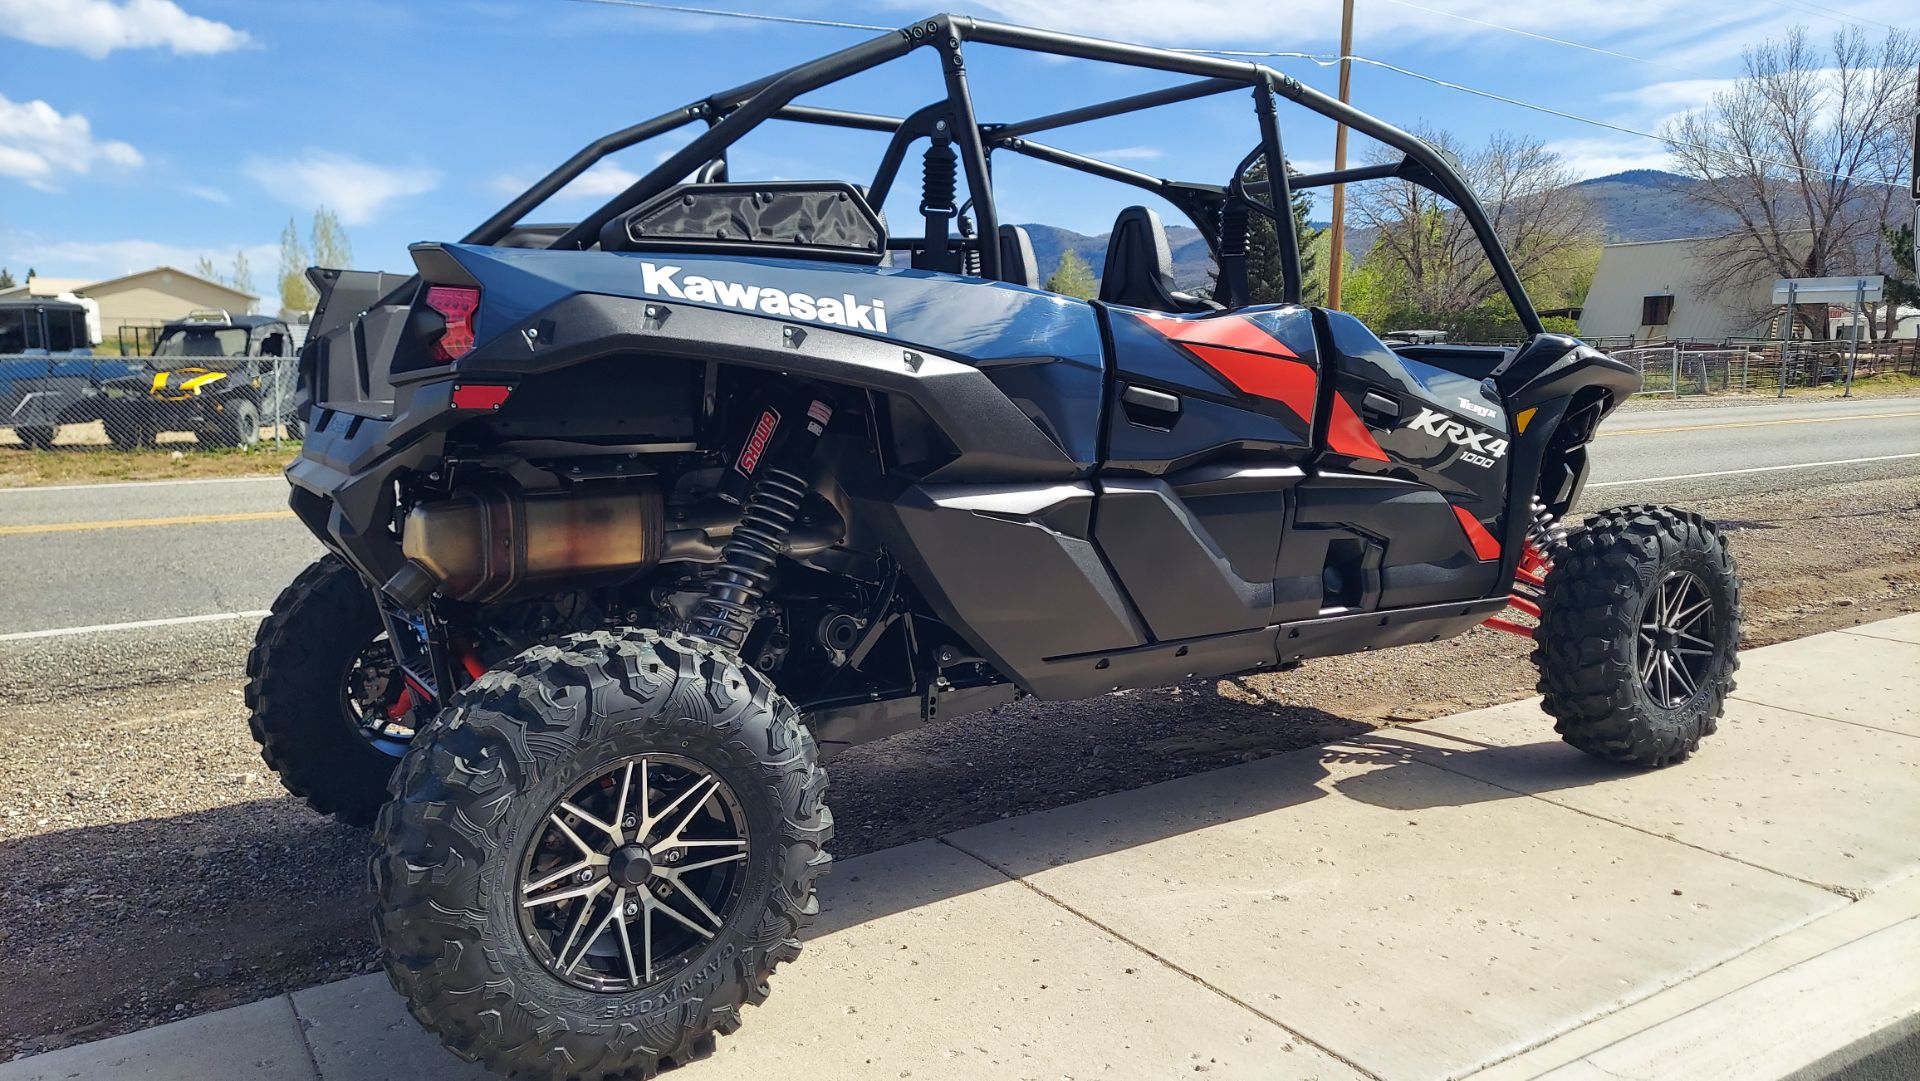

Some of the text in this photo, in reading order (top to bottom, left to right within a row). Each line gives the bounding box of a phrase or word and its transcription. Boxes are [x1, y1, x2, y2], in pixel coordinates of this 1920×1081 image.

[640, 262, 888, 333] Kawasaki
[741, 411, 776, 475] SHOWA
[1460, 451, 1496, 468] 1000
